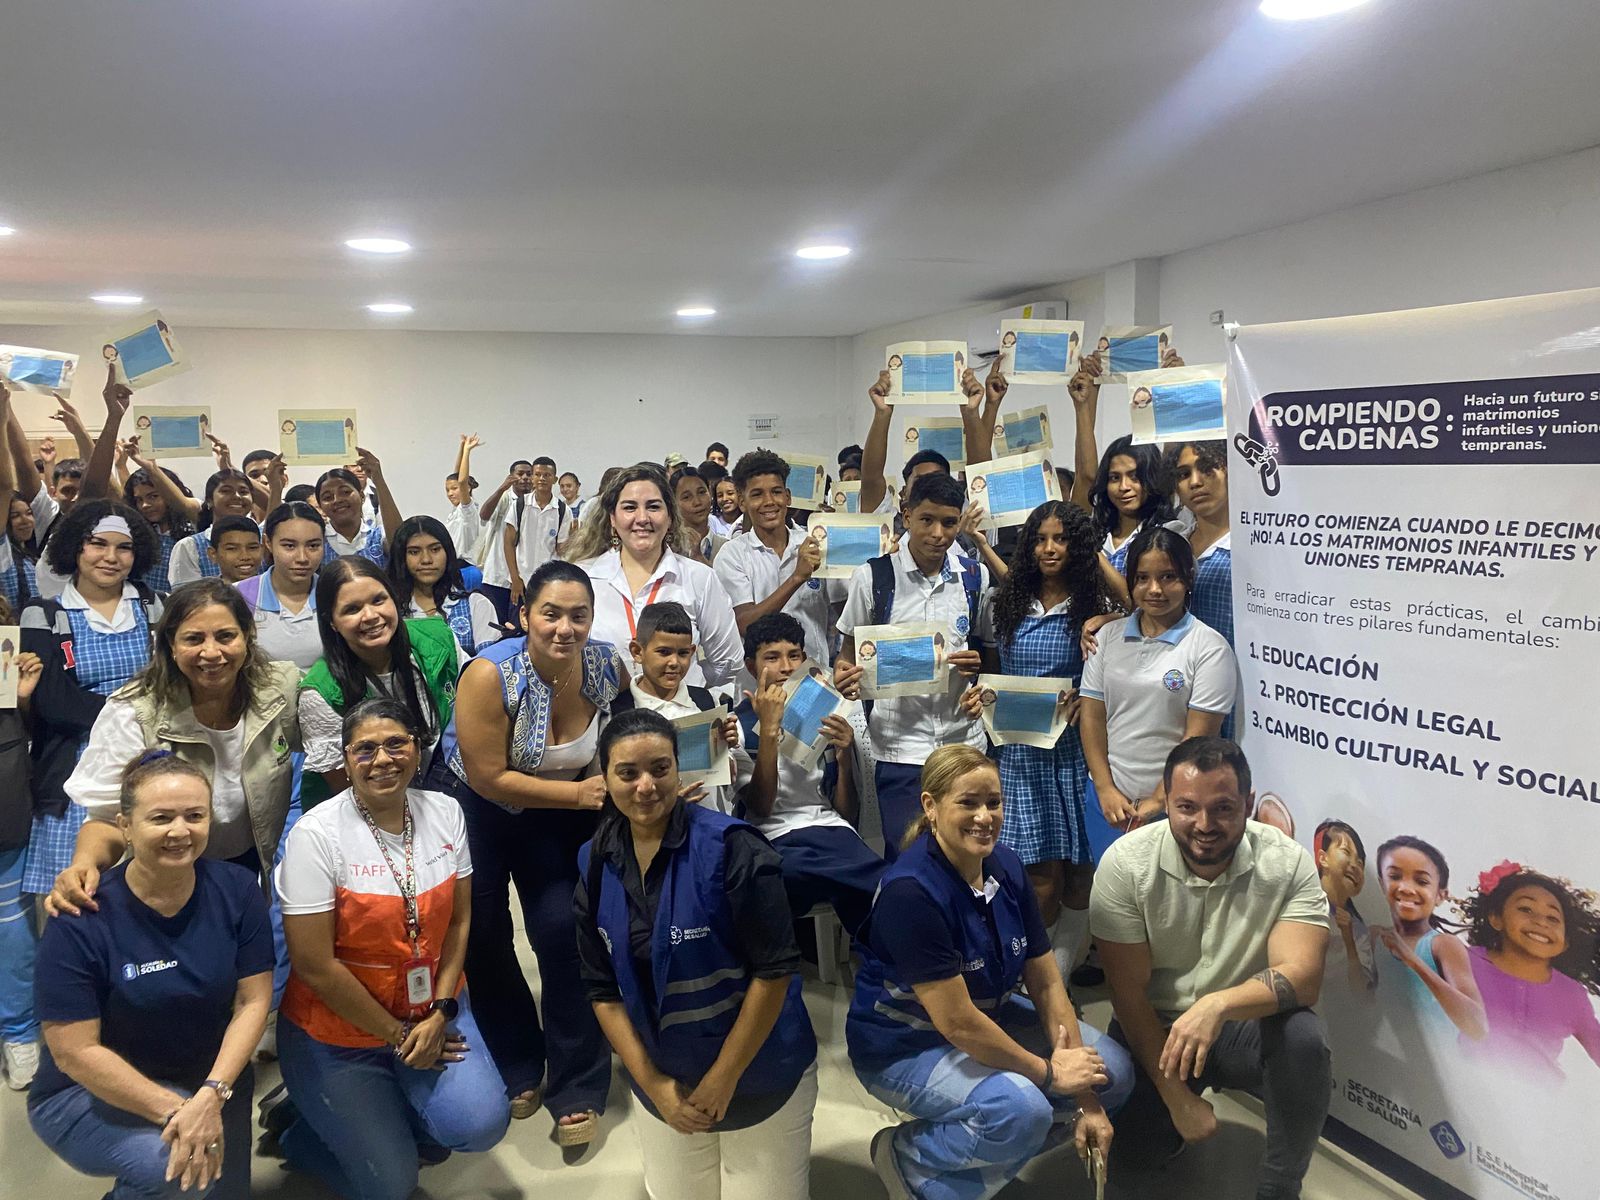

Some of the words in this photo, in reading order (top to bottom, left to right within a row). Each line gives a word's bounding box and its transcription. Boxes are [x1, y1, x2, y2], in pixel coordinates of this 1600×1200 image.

[1265, 398, 1441, 427] ROMPIENDO
[1464, 393, 1505, 406] Hacia
[1510, 394, 1528, 405] un
[1533, 391, 1585, 404] futuro
[1590, 390, 1600, 401] s
[1463, 406, 1560, 421] matrimonios
[1298, 425, 1440, 451] CADENAS
[1462, 423, 1534, 436] infantiles
[1538, 425, 1548, 437] y
[1552, 420, 1600, 434] union
[1461, 440, 1547, 453] tempranas.
[1240, 511, 1251, 525] EL
[1253, 512, 1310, 528] FUTURO
[1314, 514, 1402, 532] COMIENZA
[1407, 517, 1489, 535] CUANDO
[1495, 520, 1520, 537] LE
[1250, 529, 1272, 546] ¡NO!
[1275, 531, 1285, 545] A
[1290, 532, 1323, 548] LOS
[1327, 533, 1453, 554] MATRIMONIOS
[1458, 539, 1577, 561] INFANTILES
[1584, 545, 1598, 562] Y
[1304, 551, 1380, 570] UNIONES
[1385, 555, 1505, 578] TEMPRANAS.
[1246, 582, 1265, 599] Para
[1275, 591, 1335, 607] erradicar
[1350, 597, 1391, 612] estas
[1407, 600, 1488, 623] prácticas,
[1506, 609, 1523, 625] el
[1246, 602, 1291, 620] comienza
[1294, 610, 1318, 624] con
[1323, 612, 1354, 626] tres
[1359, 615, 1413, 633] pilares
[1417, 619, 1560, 648] fundamentales:
[1249, 642, 1259, 660] 1.
[1262, 645, 1379, 681] EDUCACIÓN
[1260, 679, 1271, 699] 2.
[1274, 683, 1408, 726] PROTECCIÓN
[1416, 708, 1502, 742] LEGAL
[1252, 711, 1262, 730] 3.
[1265, 716, 1329, 750] CAMBIO
[1334, 735, 1464, 777] CULTURAL
[1473, 760, 1490, 781] Y
[1497, 764, 1600, 804] SOCIAL
[140, 960, 178, 975] SOLEDAD
[1347, 1079, 1422, 1128] SECRETARÍA
[1347, 1091, 1364, 1108] DE
[1367, 1101, 1408, 1131] SALUD
